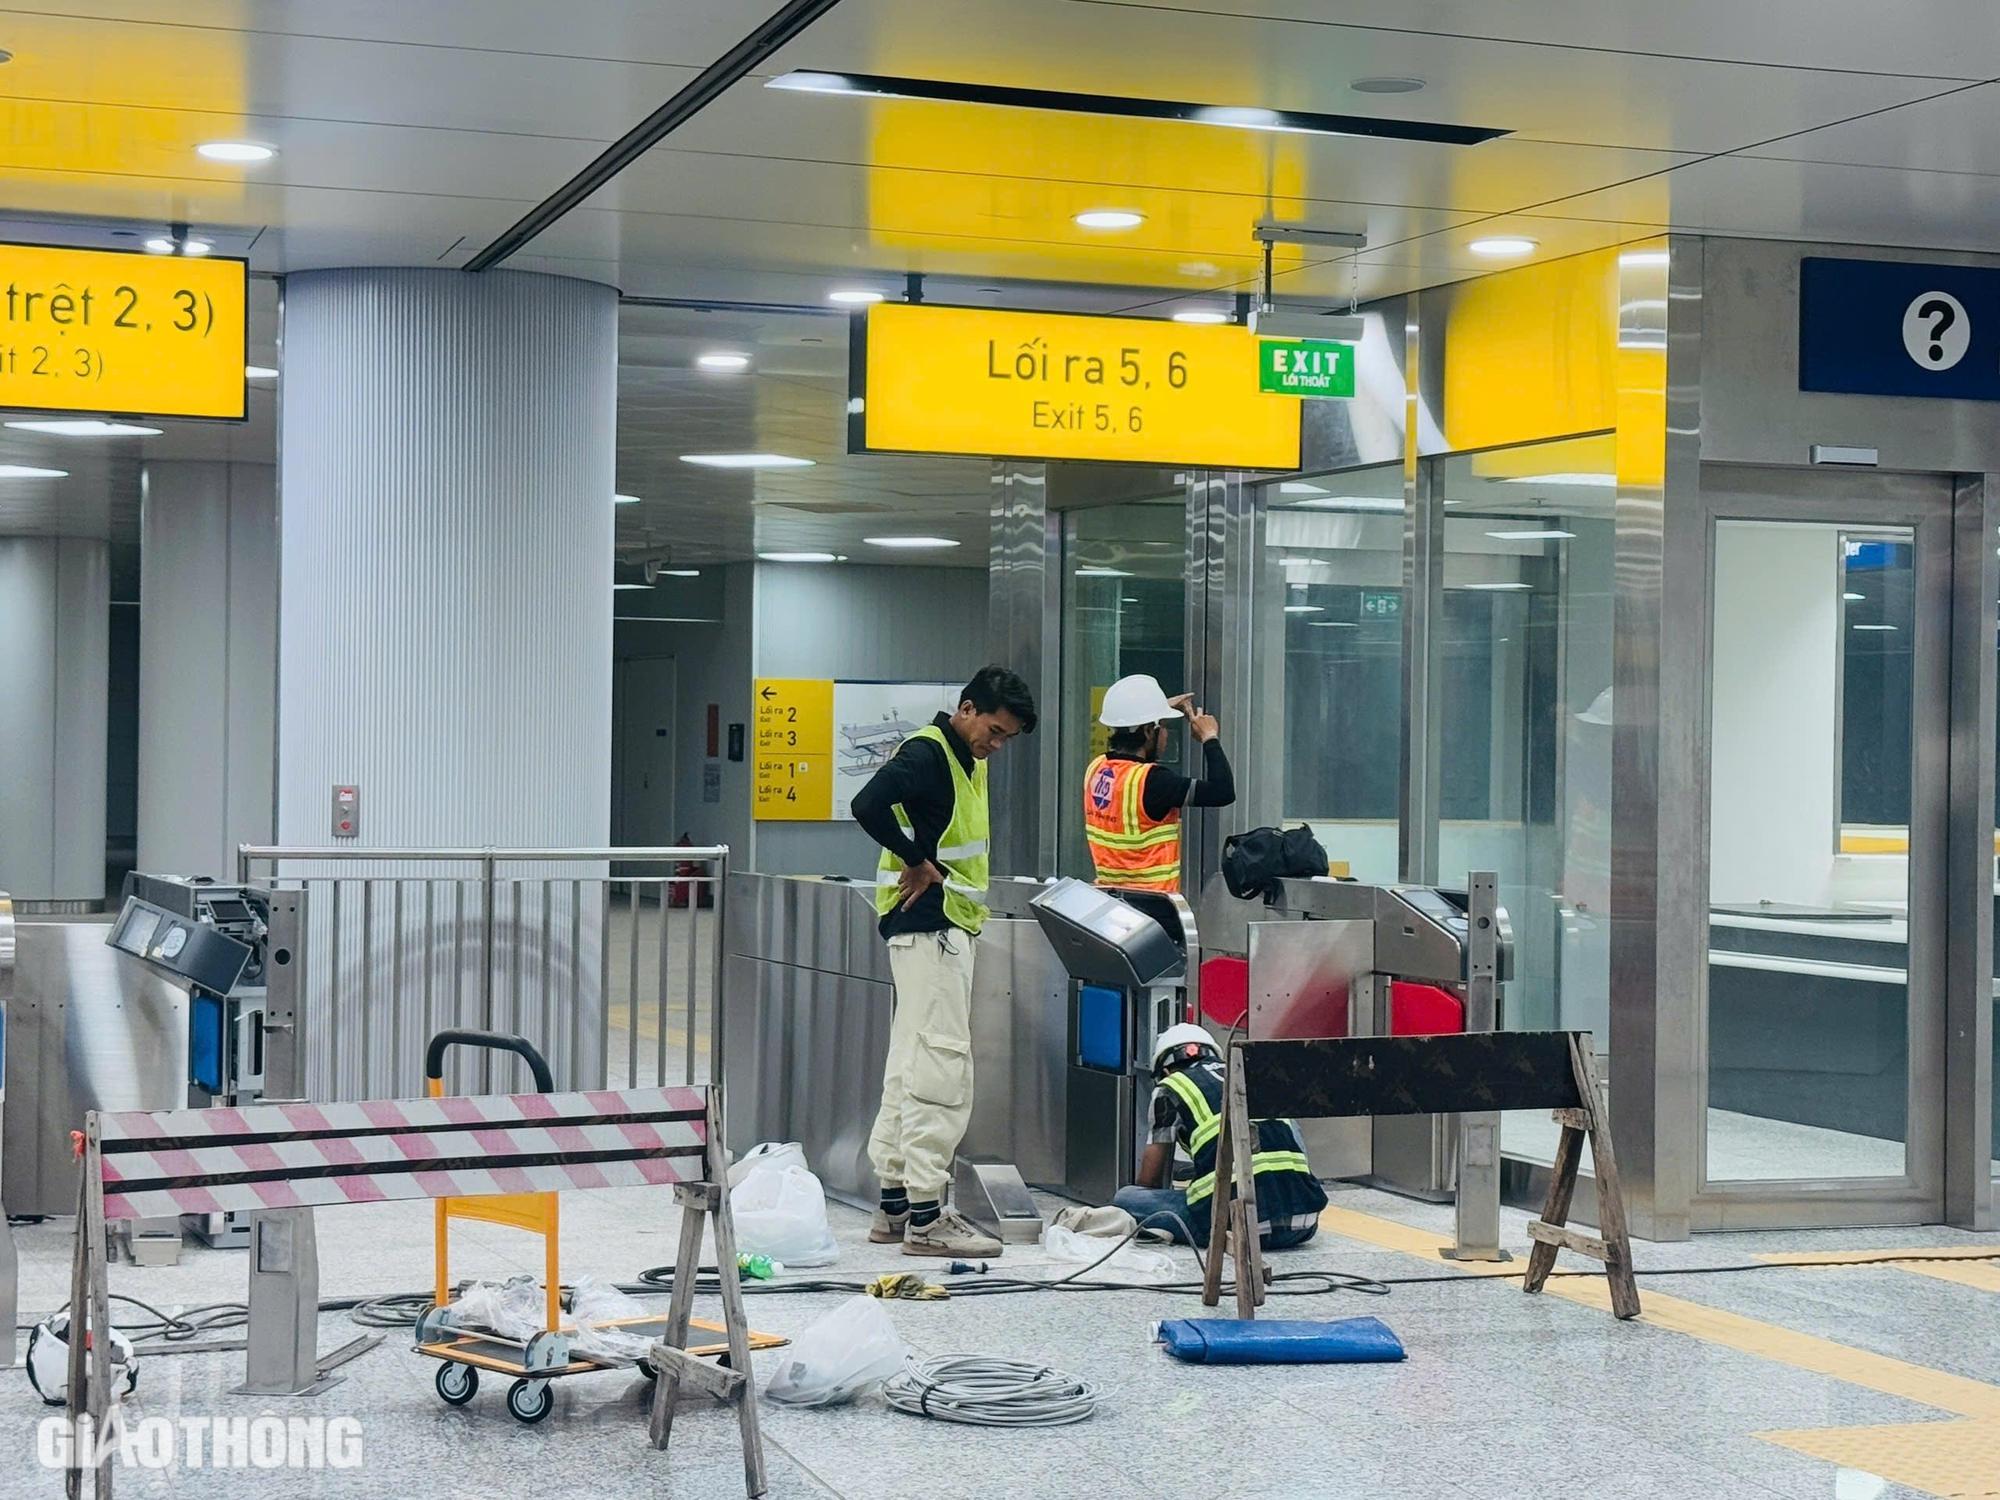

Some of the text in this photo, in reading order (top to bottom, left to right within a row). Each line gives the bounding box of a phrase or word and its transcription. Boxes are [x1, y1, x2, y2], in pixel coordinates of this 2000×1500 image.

[5, 282, 214, 338] trệt 2, 3)
[31, 345, 60, 378] 2,
[74, 348, 104, 382] 3)
[988, 337, 1188, 390] Lối ra 5, 6
[1273, 349, 1340, 375] EXIT
[1033, 400, 1143, 434] Exit 5, 6
[774, 707, 784, 715] ra
[787, 706, 797, 723] 2
[773, 731, 783, 739] ra
[787, 730, 797, 747] 3
[773, 763, 783, 771] ra
[788, 762, 795, 779] 1
[786, 786, 797, 802] 4
